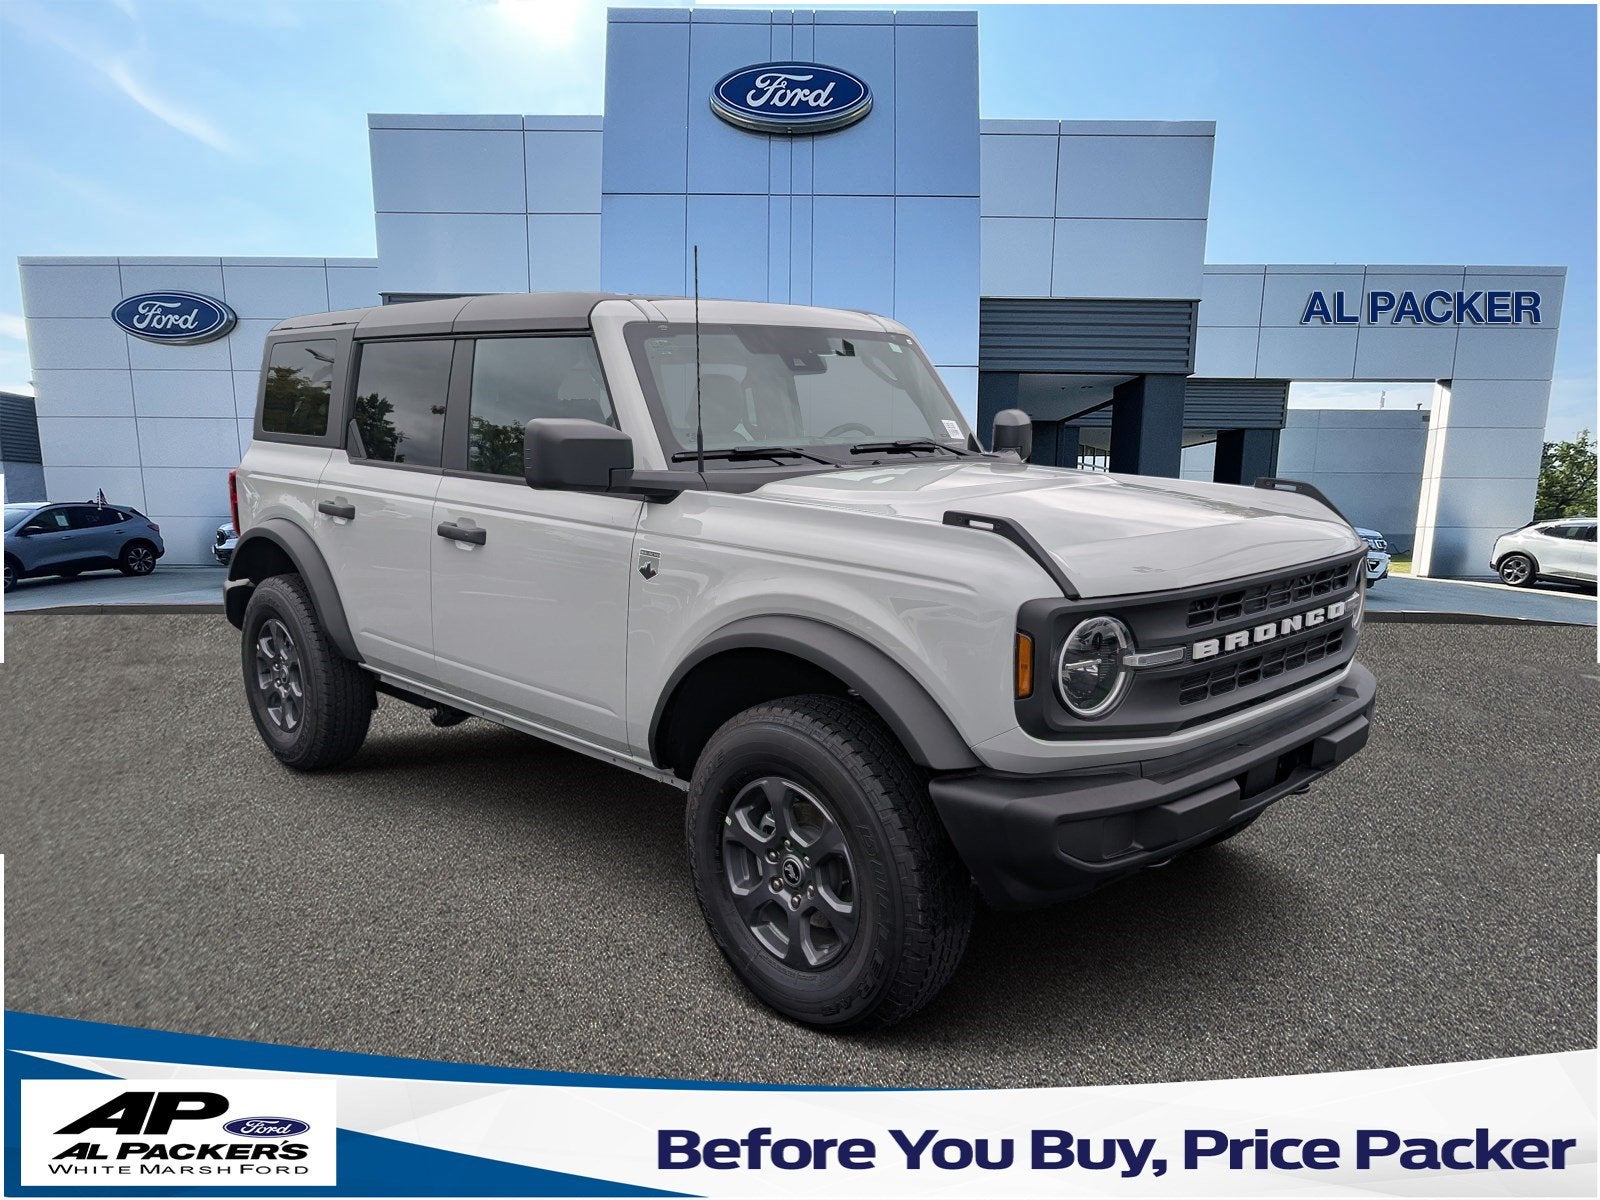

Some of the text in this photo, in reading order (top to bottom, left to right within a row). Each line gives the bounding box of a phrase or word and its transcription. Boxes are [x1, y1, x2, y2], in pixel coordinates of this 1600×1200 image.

[746, 73, 836, 107] Ford
[133, 300, 199, 329] Ford
[1301, 290, 1541, 325] AL PACKER
[1193, 601, 1345, 660] BRONCO
